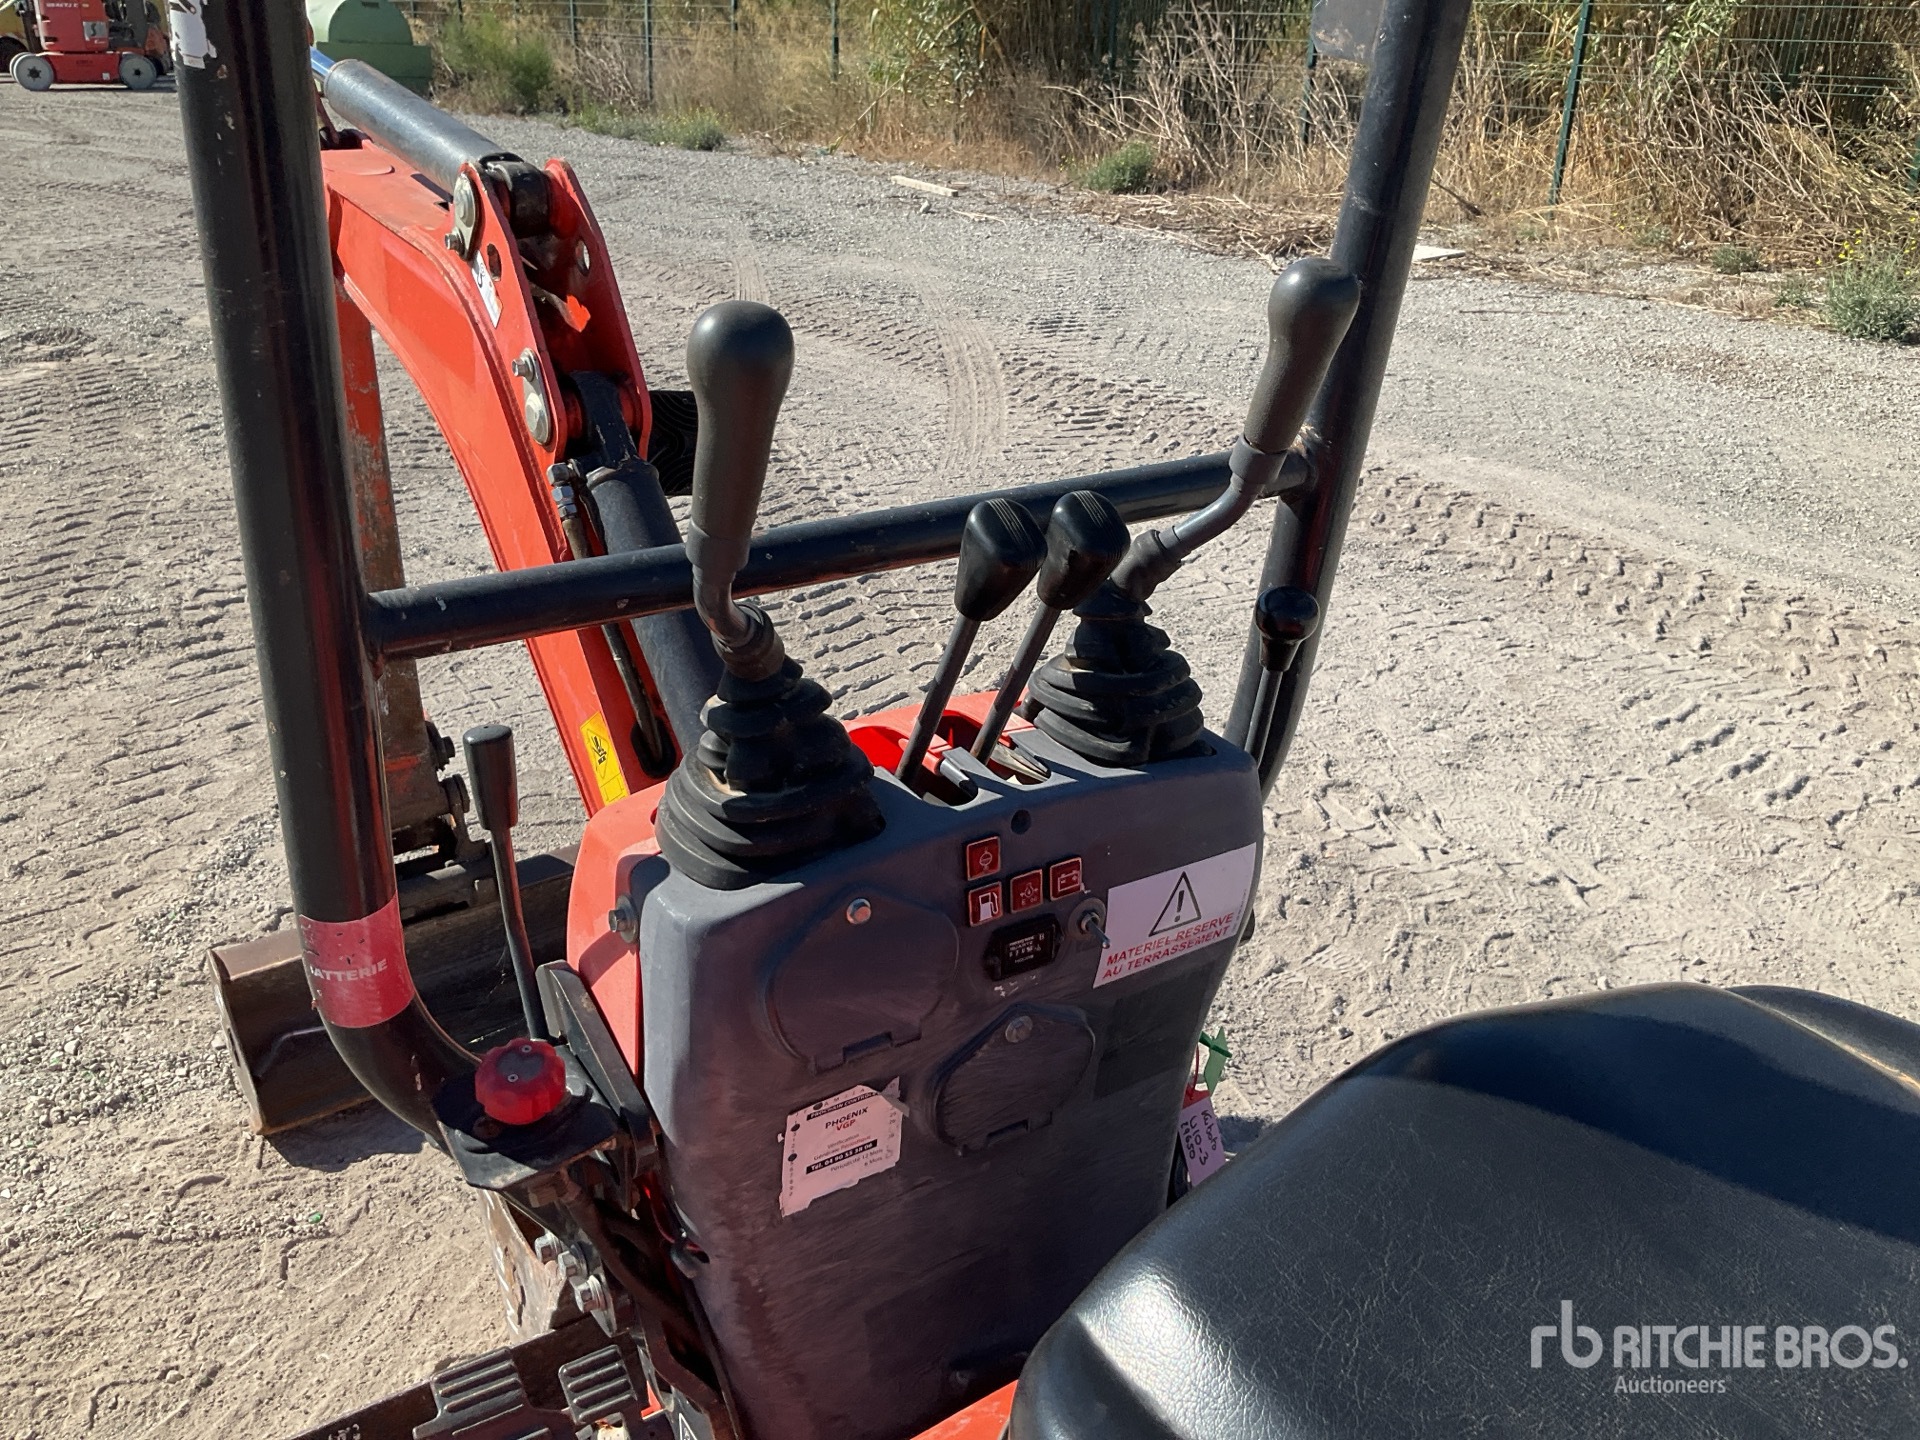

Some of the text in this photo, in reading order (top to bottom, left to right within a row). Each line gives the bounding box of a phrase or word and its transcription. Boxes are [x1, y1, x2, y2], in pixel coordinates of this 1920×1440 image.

[1106, 912, 1235, 966] MATERIEL RESERVE
[1103, 926, 1231, 979] AU TERRASSEMENT
[310, 958, 388, 981] ATTERIE
[825, 1107, 868, 1129] PHOENIX
[836, 1119, 856, 1131] VGP
